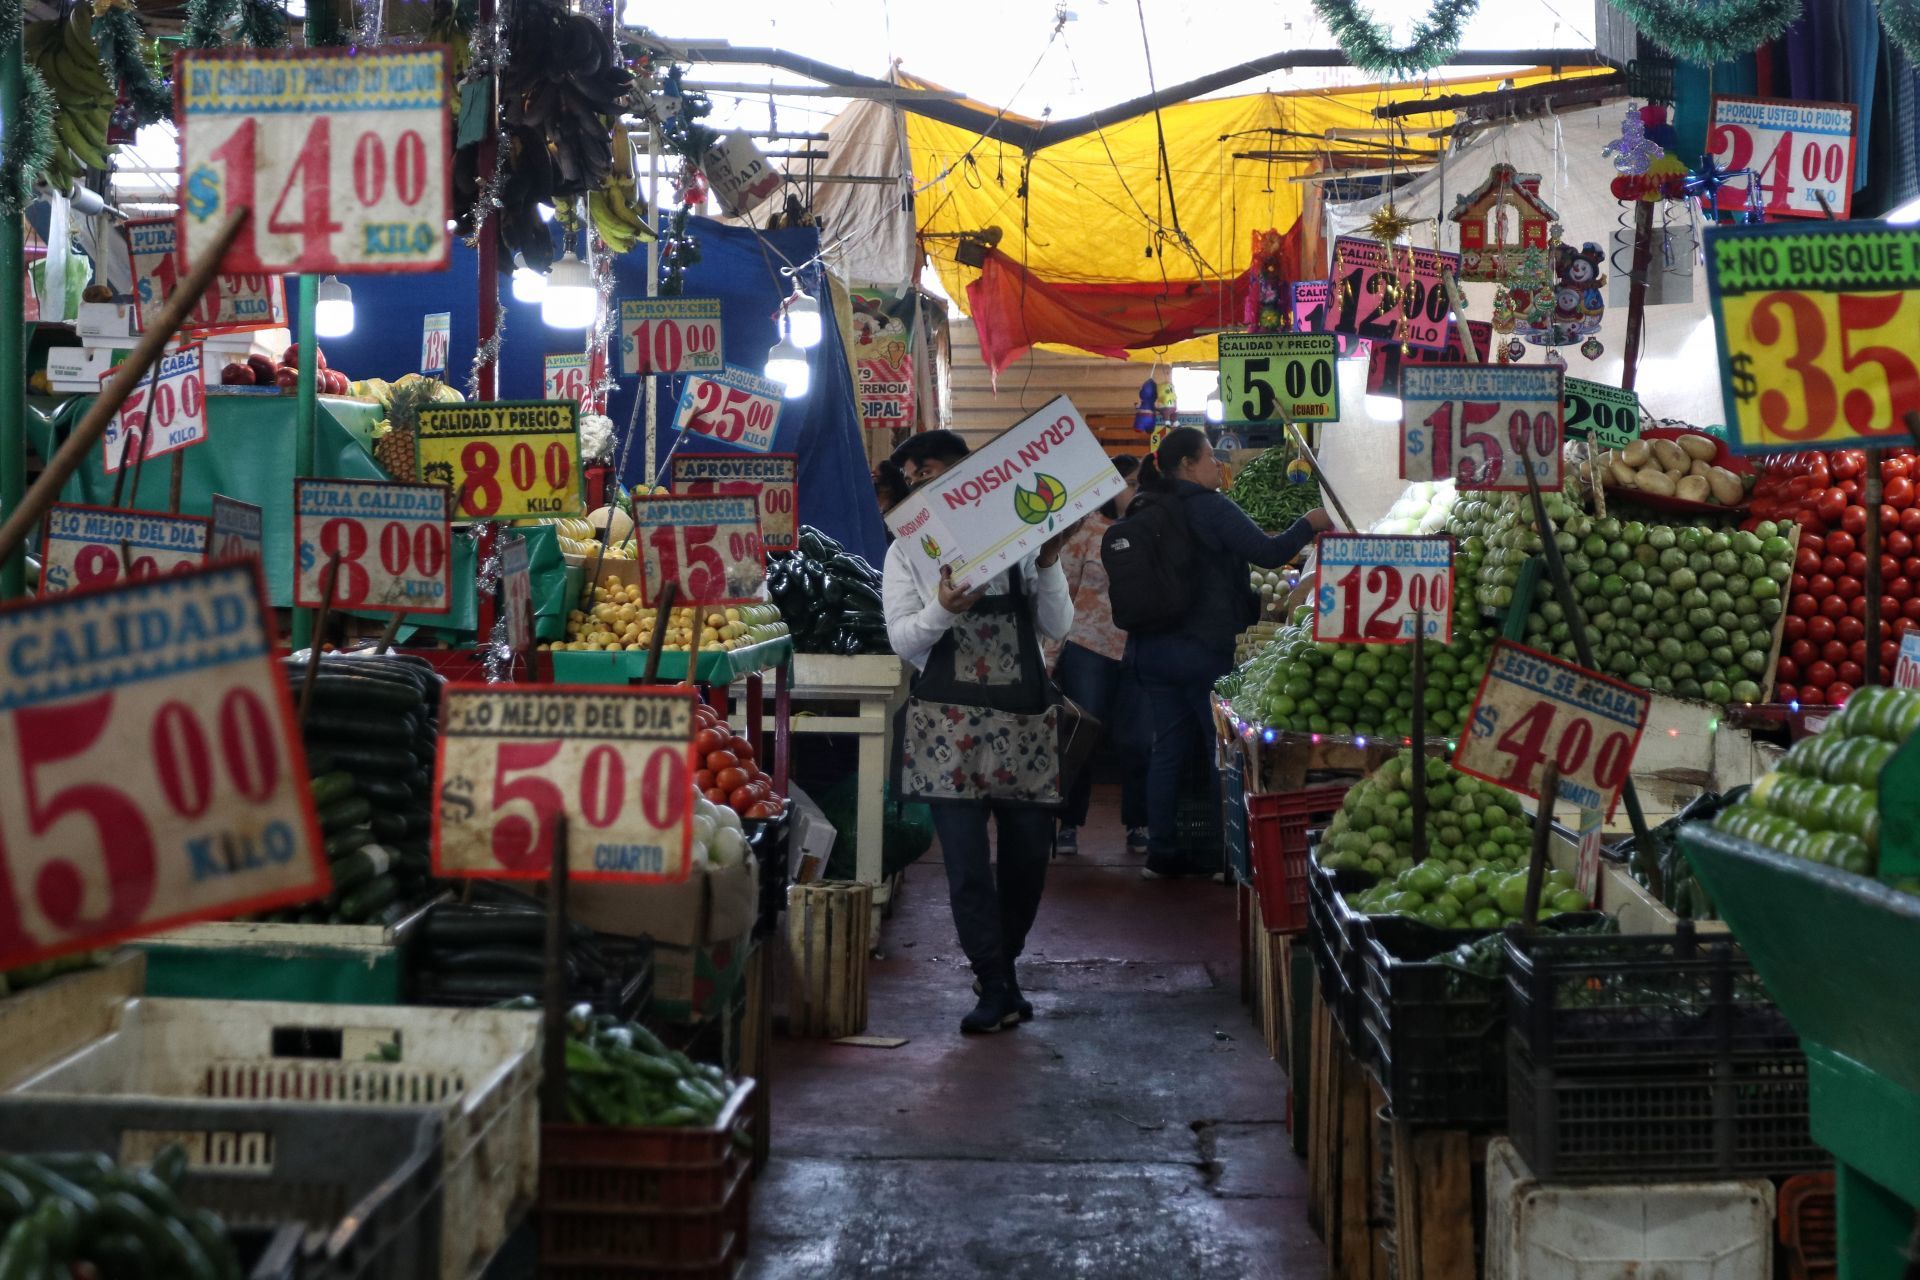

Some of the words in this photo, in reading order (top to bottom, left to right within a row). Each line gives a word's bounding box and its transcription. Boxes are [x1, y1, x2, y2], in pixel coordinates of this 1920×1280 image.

[217, 68, 287, 97] CALIDAD
[303, 66, 360, 95] PRECIO
[387, 63, 436, 92] MEJOR
[1725, 104, 1765, 120] PORQUE
[1767, 107, 1798, 123] USTED
[1801, 111, 1814, 124] LO
[1815, 112, 1842, 126] PIDIO
[1806, 187, 1836, 203] KO
[134, 229, 177, 247] PURA
[364, 222, 434, 256] KILO
[1739, 246, 1779, 276] NO
[1788, 242, 1904, 274] BUSQUE
[1299, 287, 1328, 298] CALID
[234, 299, 268, 315] KILO
[624, 303, 719, 315] APROVECHE
[1409, 326, 1438, 343] ILO
[1223, 340, 1273, 351] CALIDAD
[1276, 341, 1284, 351] Y
[1287, 339, 1331, 350] PRECIO
[158, 352, 194, 373] CABA
[694, 355, 720, 367] KILO
[756, 381, 778, 395] MAS
[1419, 373, 1431, 391] LO
[1433, 373, 1465, 390] MEJOR
[1475, 374, 1489, 390] DE
[1490, 373, 1547, 391] TEMPORADA
[1591, 387, 1633, 402] PRECIO
[1296, 403, 1324, 416] CUARTO
[430, 413, 492, 431] CALIDAD
[495, 412, 505, 427] Y
[509, 410, 560, 428] PRECIO
[168, 426, 197, 445] KILO
[743, 431, 767, 447] KILO
[1017, 415, 1075, 467] GRAN
[683, 462, 785, 477] APROVECHE
[942, 458, 1022, 510] VISIÓN
[301, 489, 353, 508] PURA
[358, 491, 443, 512] CALIDAD
[527, 498, 562, 512] KILO
[646, 502, 746, 520] APROVECHE
[60, 515, 80, 535] LO
[84, 517, 134, 539] MEJOR
[138, 523, 166, 543] DEL
[170, 526, 196, 545] DIA
[763, 533, 793, 547] KILO
[1333, 542, 1348, 557] LO
[1351, 542, 1392, 558] MEJOR
[1399, 543, 1417, 558] DEL
[1420, 543, 1441, 558] DIA
[8, 593, 246, 678] CALIDAD
[1403, 619, 1438, 635] KO
[1504, 656, 1550, 684] ESTO
[1552, 673, 1576, 694] SE
[1577, 685, 1637, 718] ACABA
[464, 703, 494, 726] LO
[501, 702, 577, 727] MEJOR
[585, 703, 625, 728] DEL
[633, 705, 673, 730] DIA
[185, 819, 295, 882] KILO
[594, 843, 664, 872] CUARTO
